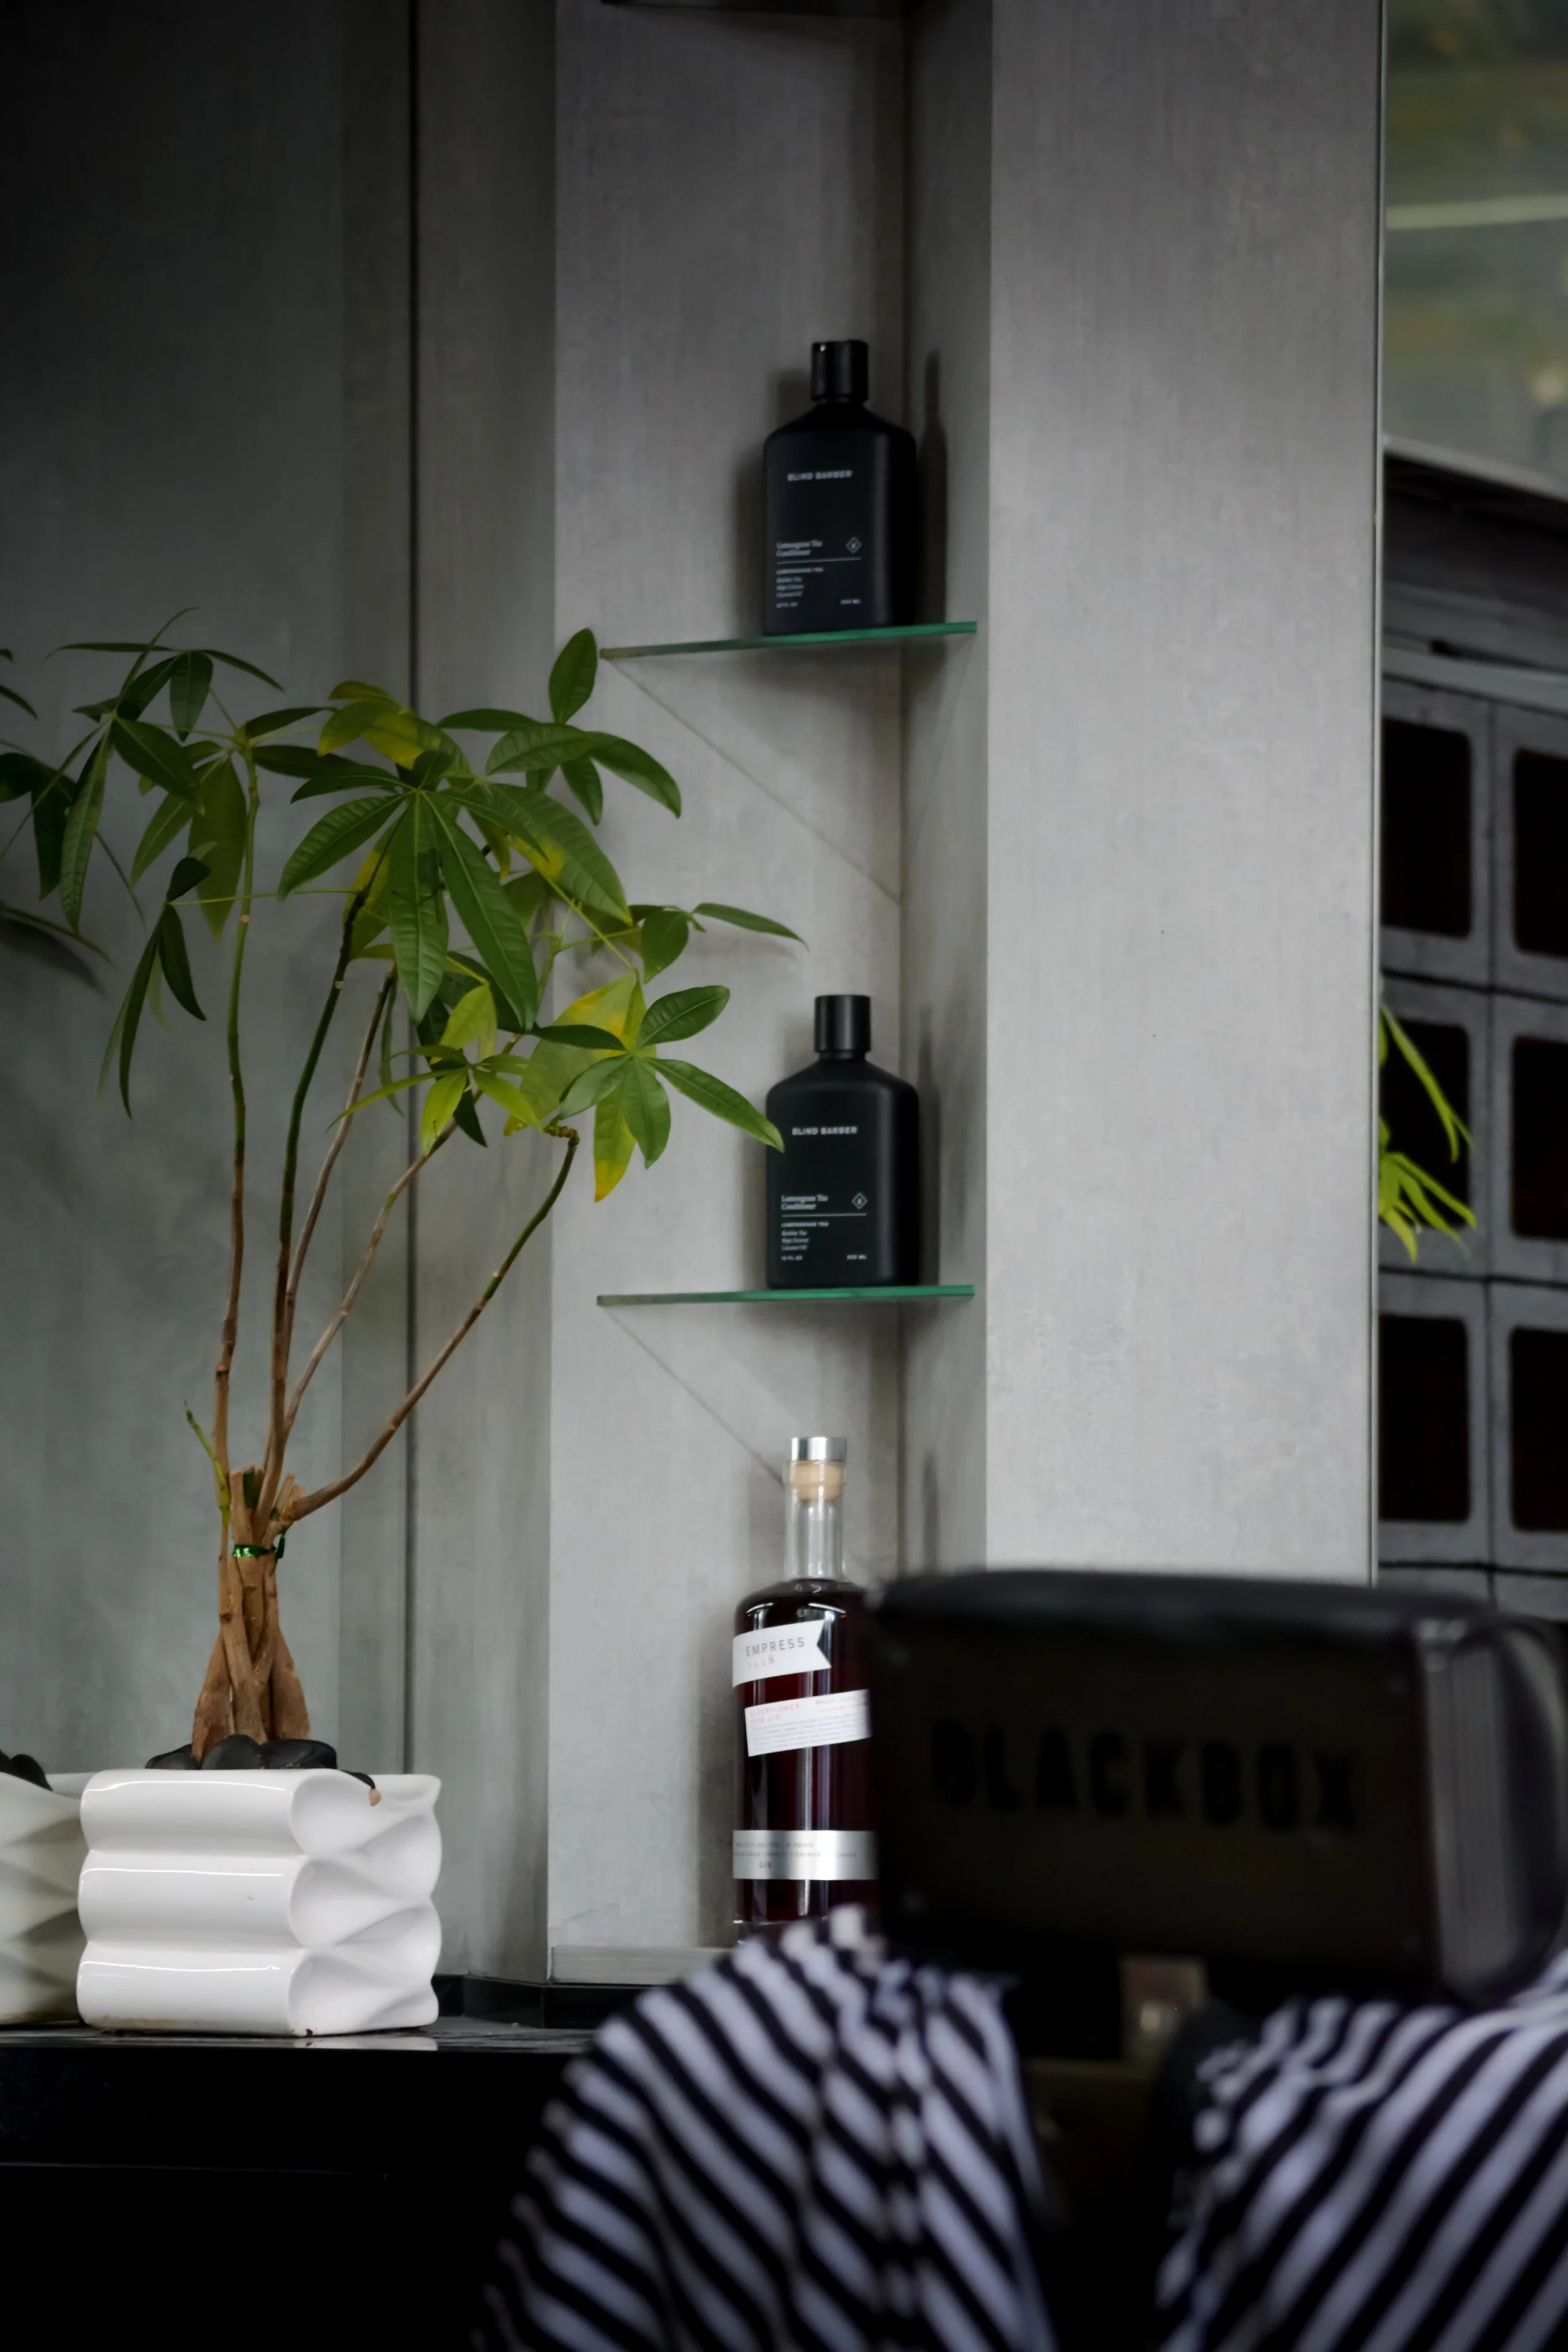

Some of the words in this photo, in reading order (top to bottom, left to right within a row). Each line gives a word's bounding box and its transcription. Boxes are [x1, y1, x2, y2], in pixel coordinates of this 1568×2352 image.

[820, 1126, 857, 1135] BARBER
[745, 1636, 805, 1657] EMPRESS
[932, 1719, 1356, 1832] BLACKBOX
